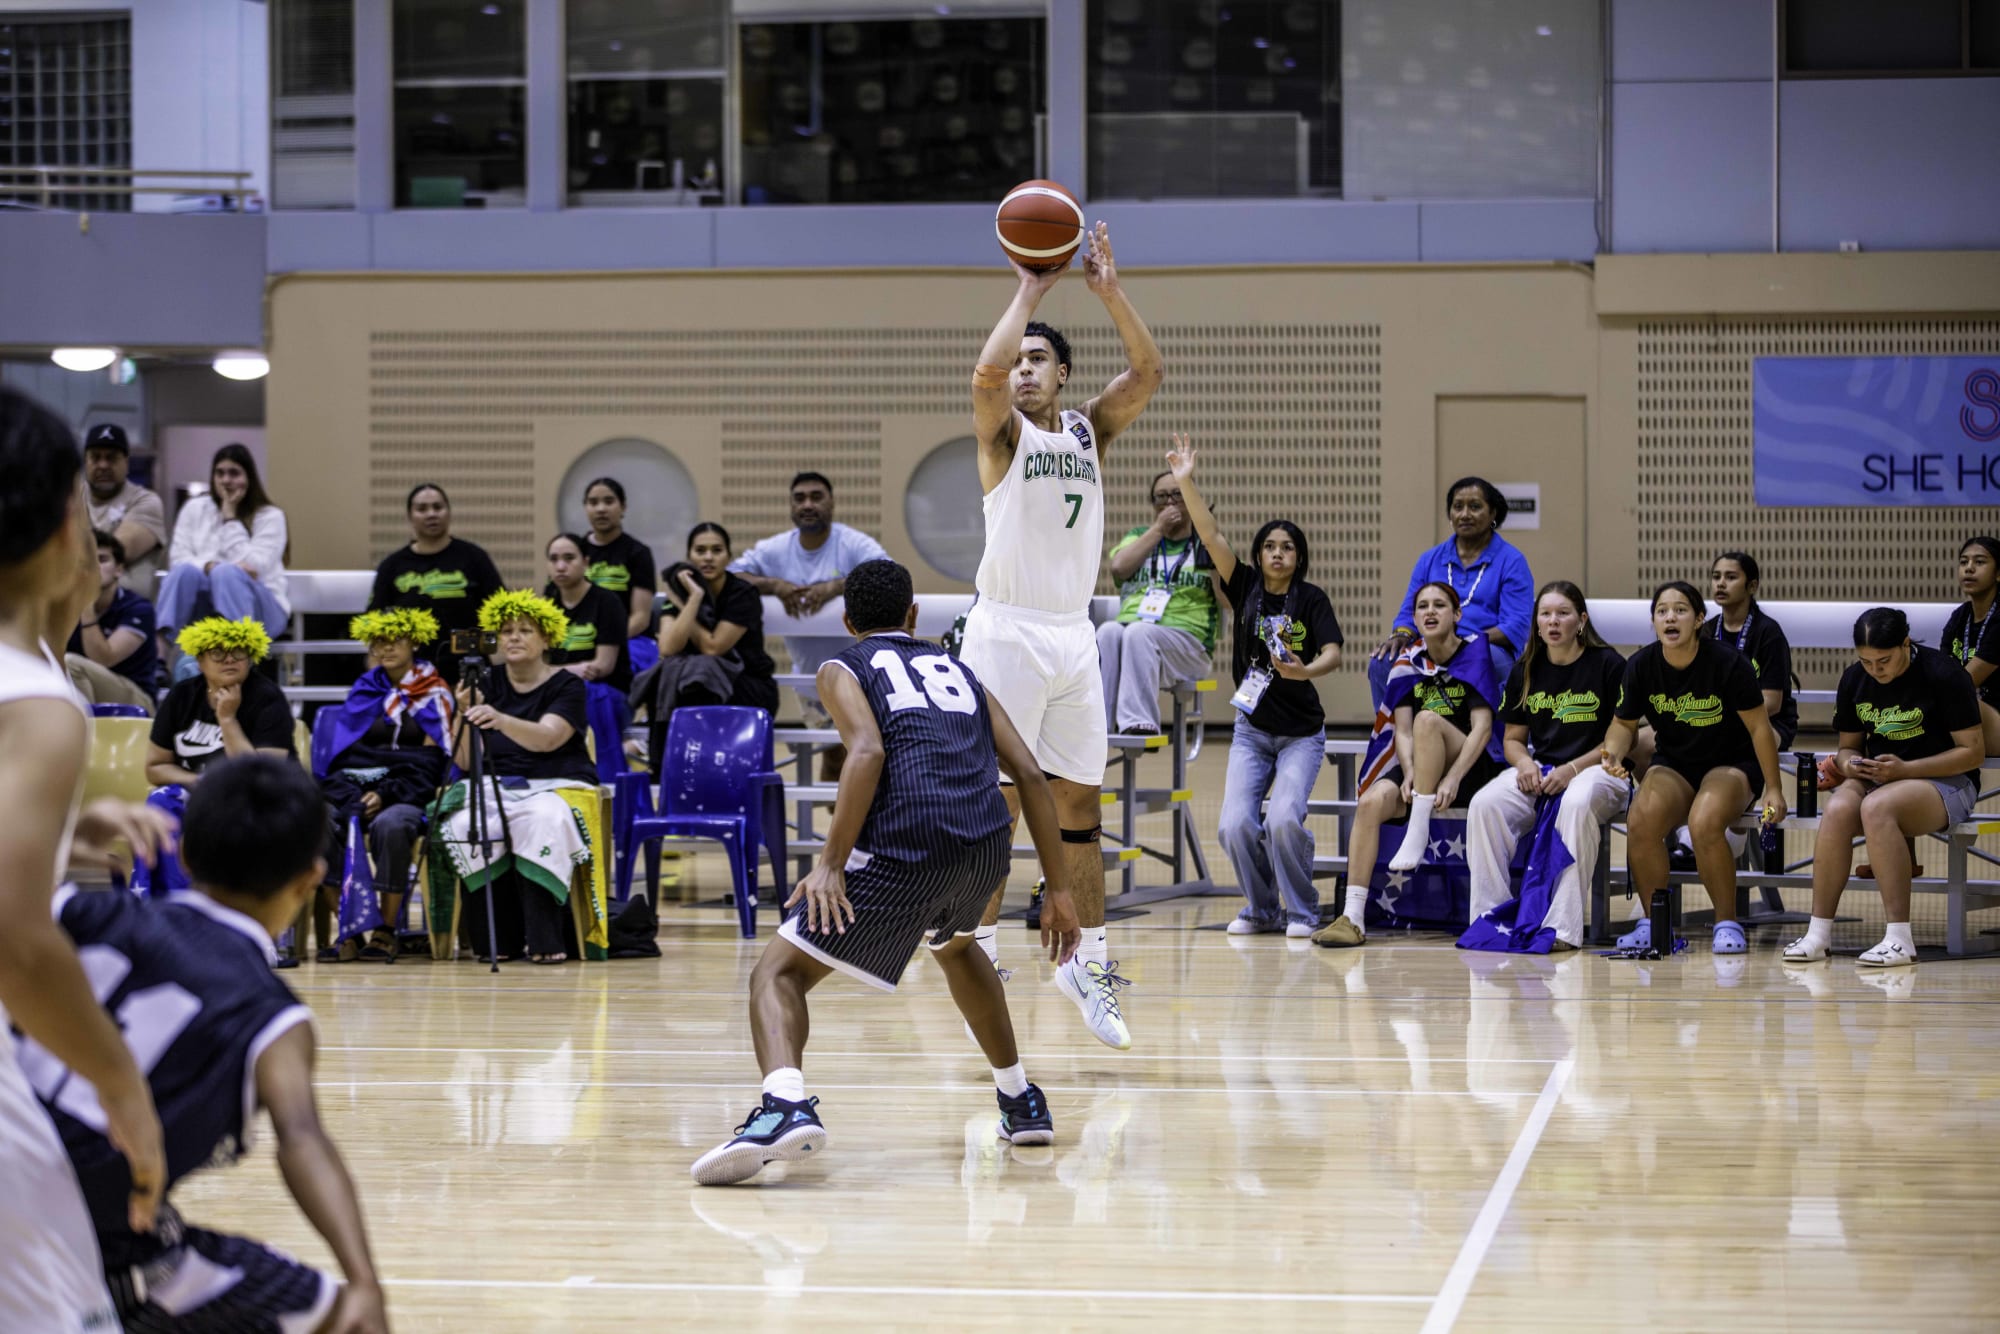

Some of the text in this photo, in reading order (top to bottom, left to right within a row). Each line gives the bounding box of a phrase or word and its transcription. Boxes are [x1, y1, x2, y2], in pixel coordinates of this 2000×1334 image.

[1861, 454, 1944, 492] SHE
[1064, 493, 1083, 529] 7
[869, 649, 977, 716] 18
